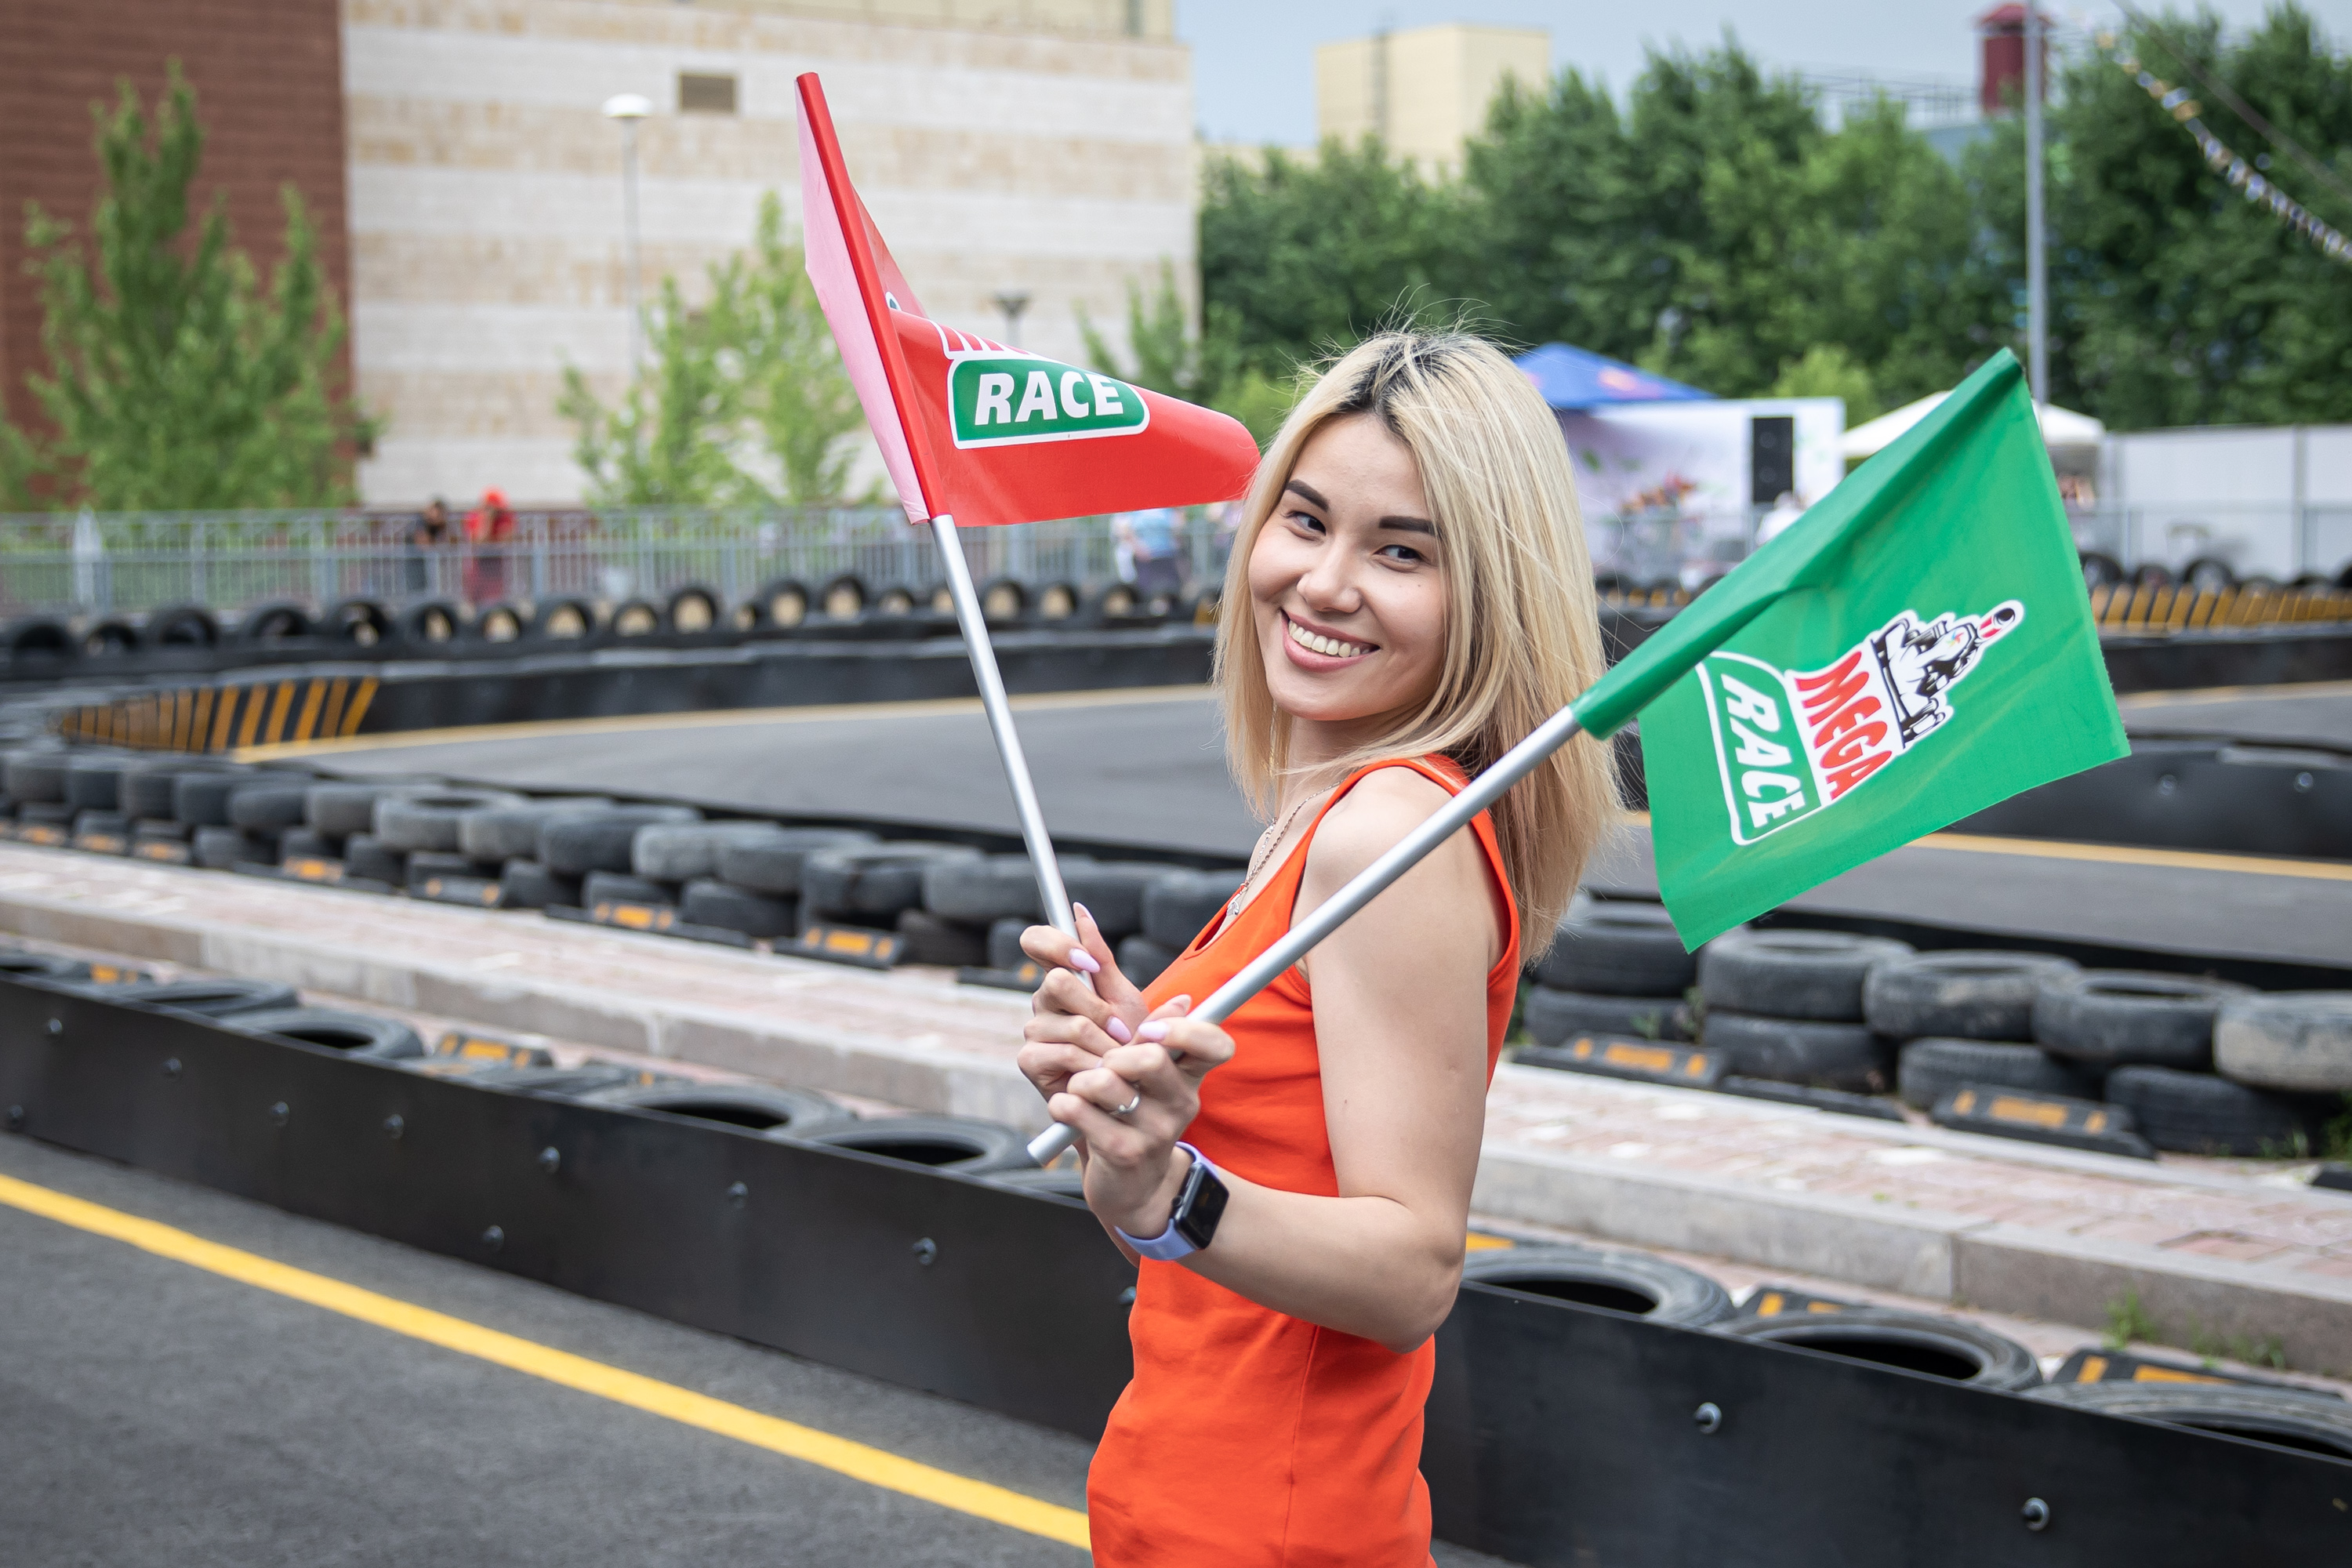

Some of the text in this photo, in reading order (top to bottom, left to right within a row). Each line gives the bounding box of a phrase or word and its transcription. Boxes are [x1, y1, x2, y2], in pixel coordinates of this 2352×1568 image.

[975, 370, 1123, 425] RACE
[1721, 673, 1805, 829] RACE
[1795, 650, 1893, 800] MEGA
